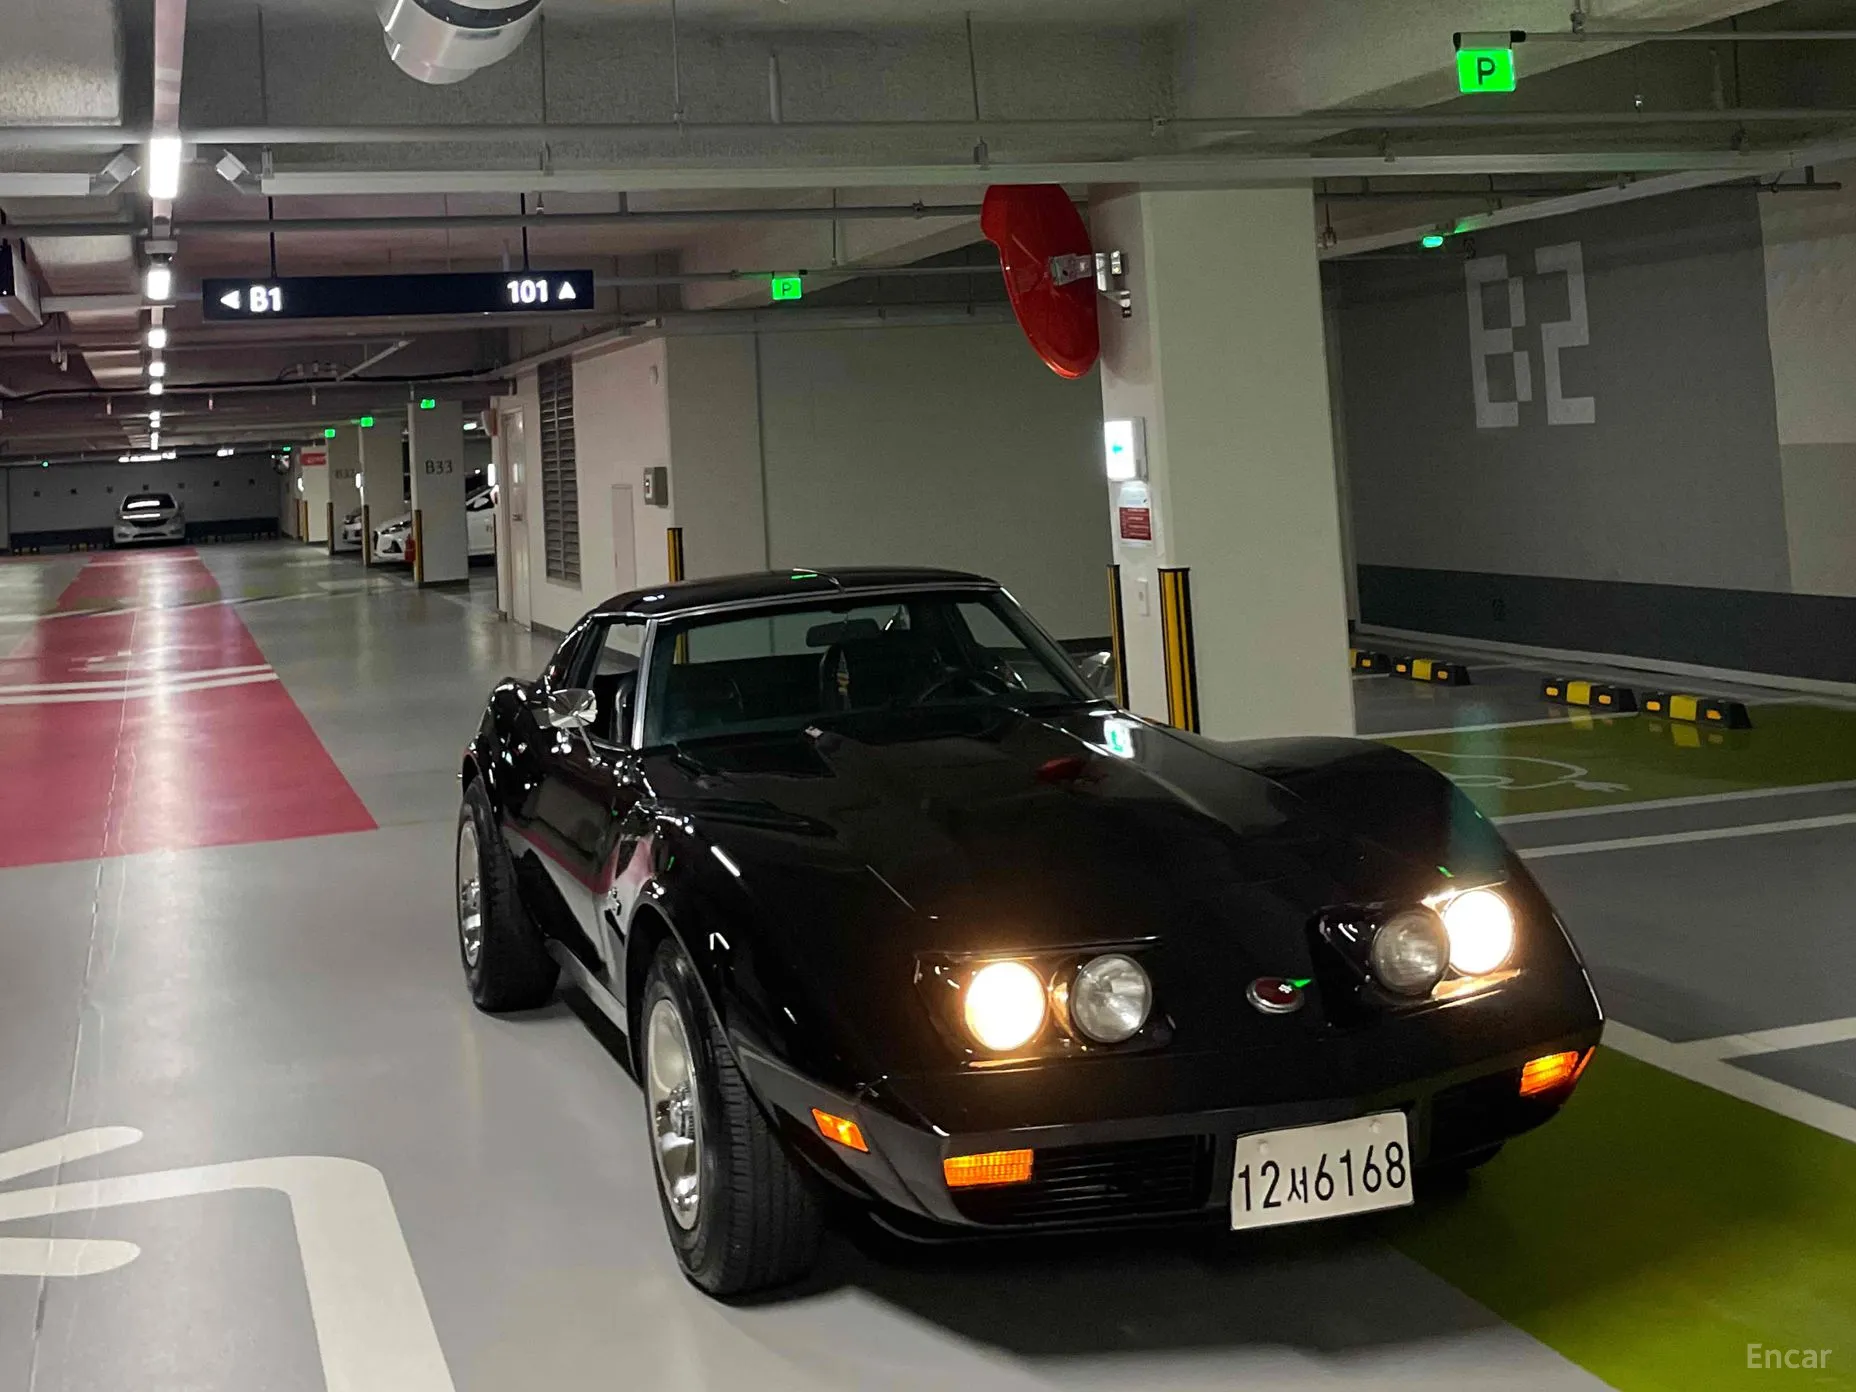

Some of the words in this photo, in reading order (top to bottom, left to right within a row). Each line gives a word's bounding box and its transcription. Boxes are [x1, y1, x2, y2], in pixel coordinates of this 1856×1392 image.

[1477, 56, 1496, 86] P
[250, 286, 283, 312] B1
[507, 279, 549, 303] 101
[782, 282, 793, 297] P
[1464, 240, 1596, 429] B2
[425, 459, 453, 475] B33
